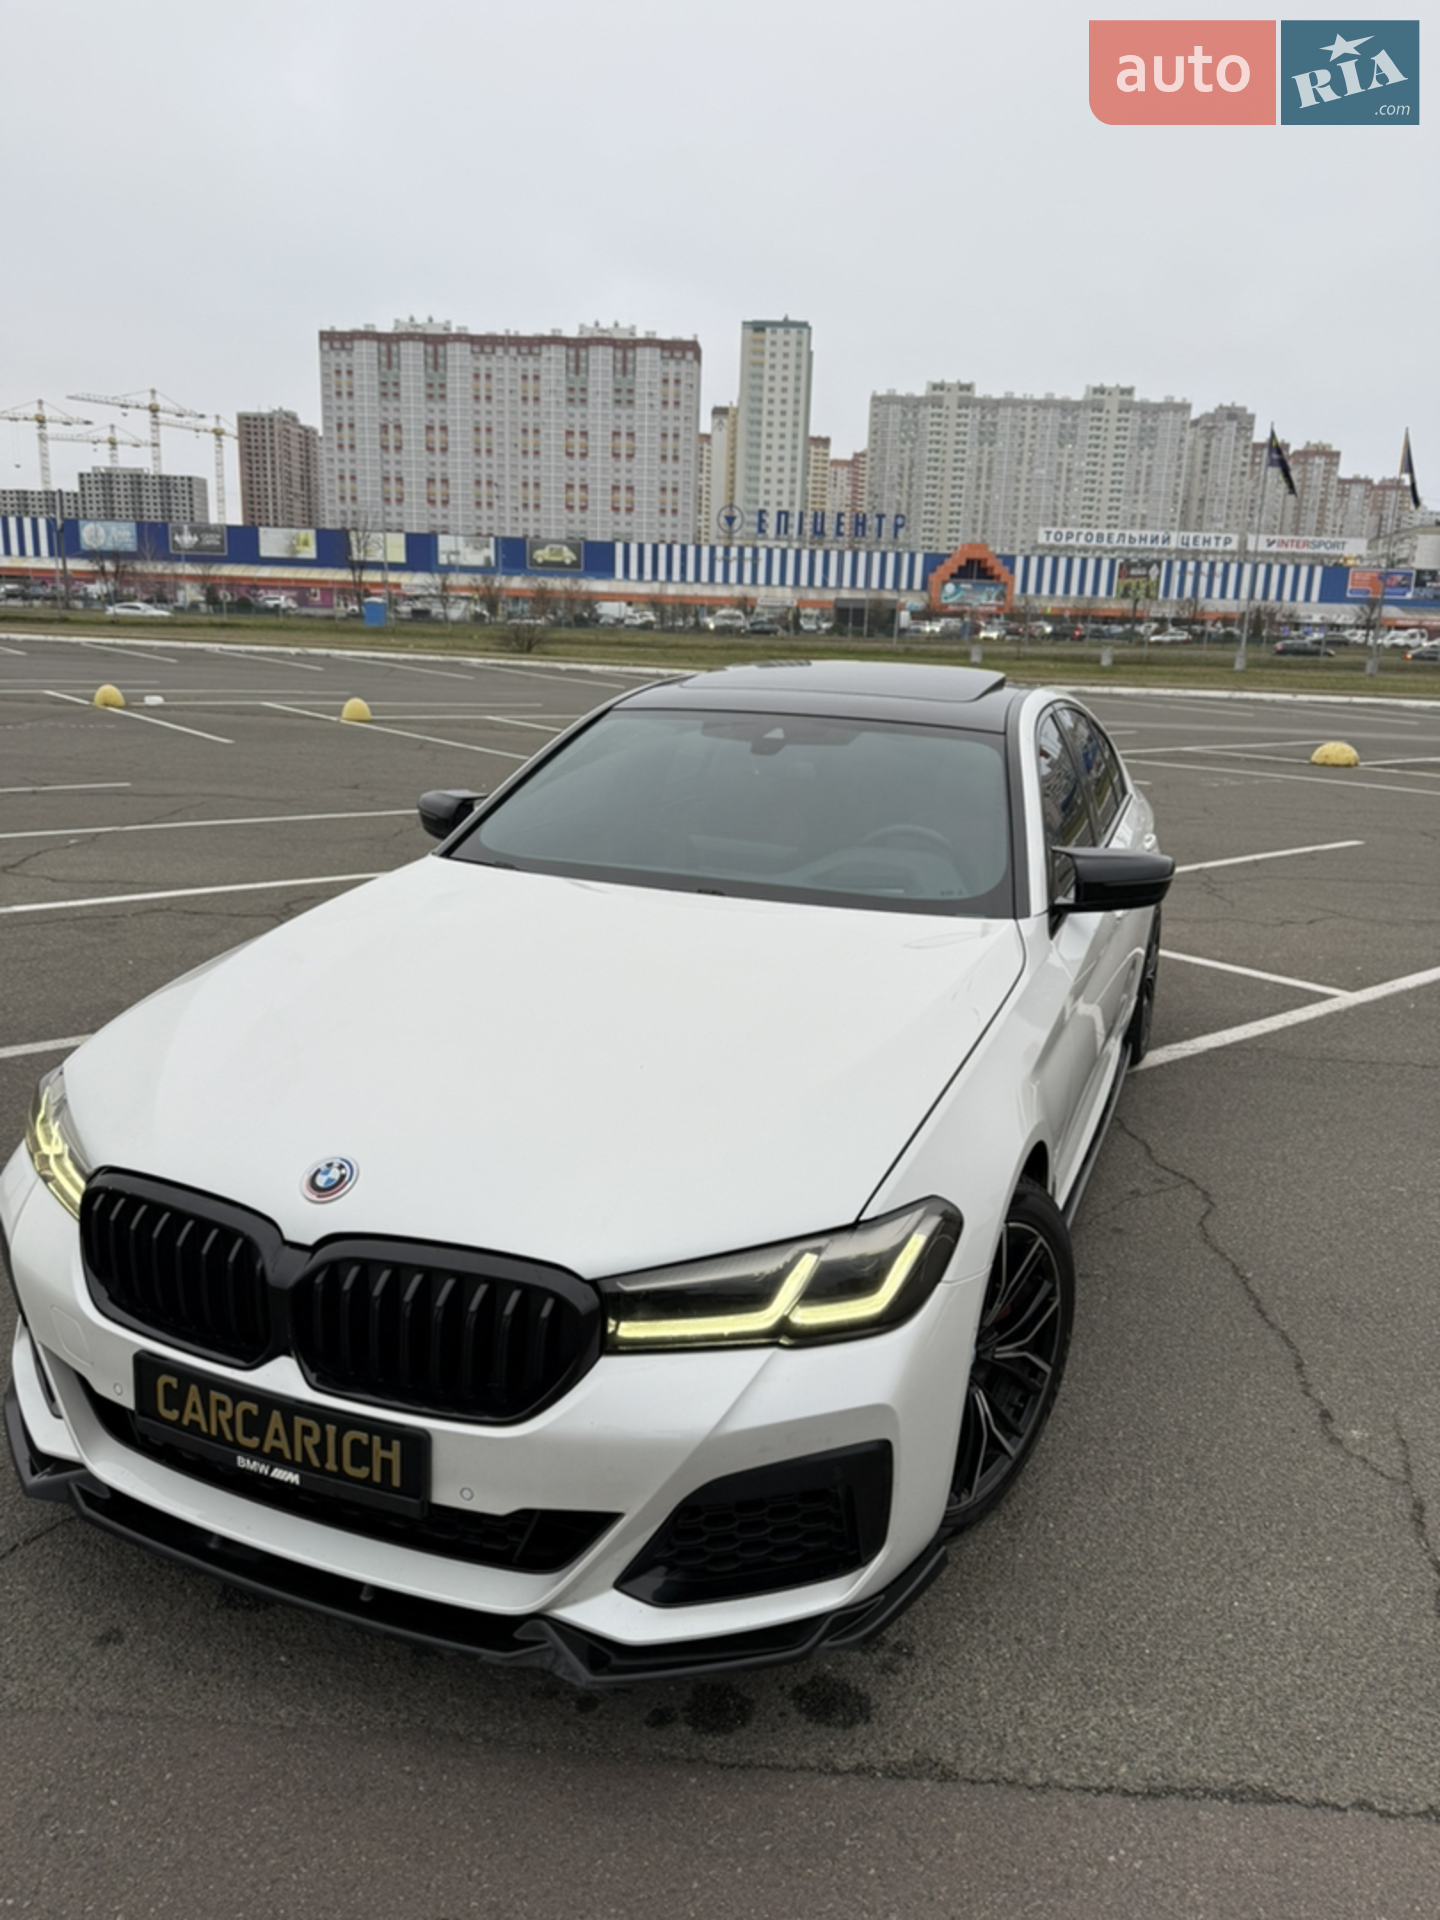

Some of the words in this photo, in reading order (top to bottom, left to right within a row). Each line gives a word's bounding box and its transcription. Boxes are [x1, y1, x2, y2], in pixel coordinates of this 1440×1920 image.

[756, 508, 906, 539] ЕПІЦЕНТР
[1044, 529, 1171, 546] ТОРГОВЕЛЬНИЙ
[1179, 534, 1233, 547] ЦЕНТР
[1276, 537, 1346, 550] INTERSPORT
[156, 1374, 401, 1488] CARCARICH
[236, 1455, 271, 1476] BMW
